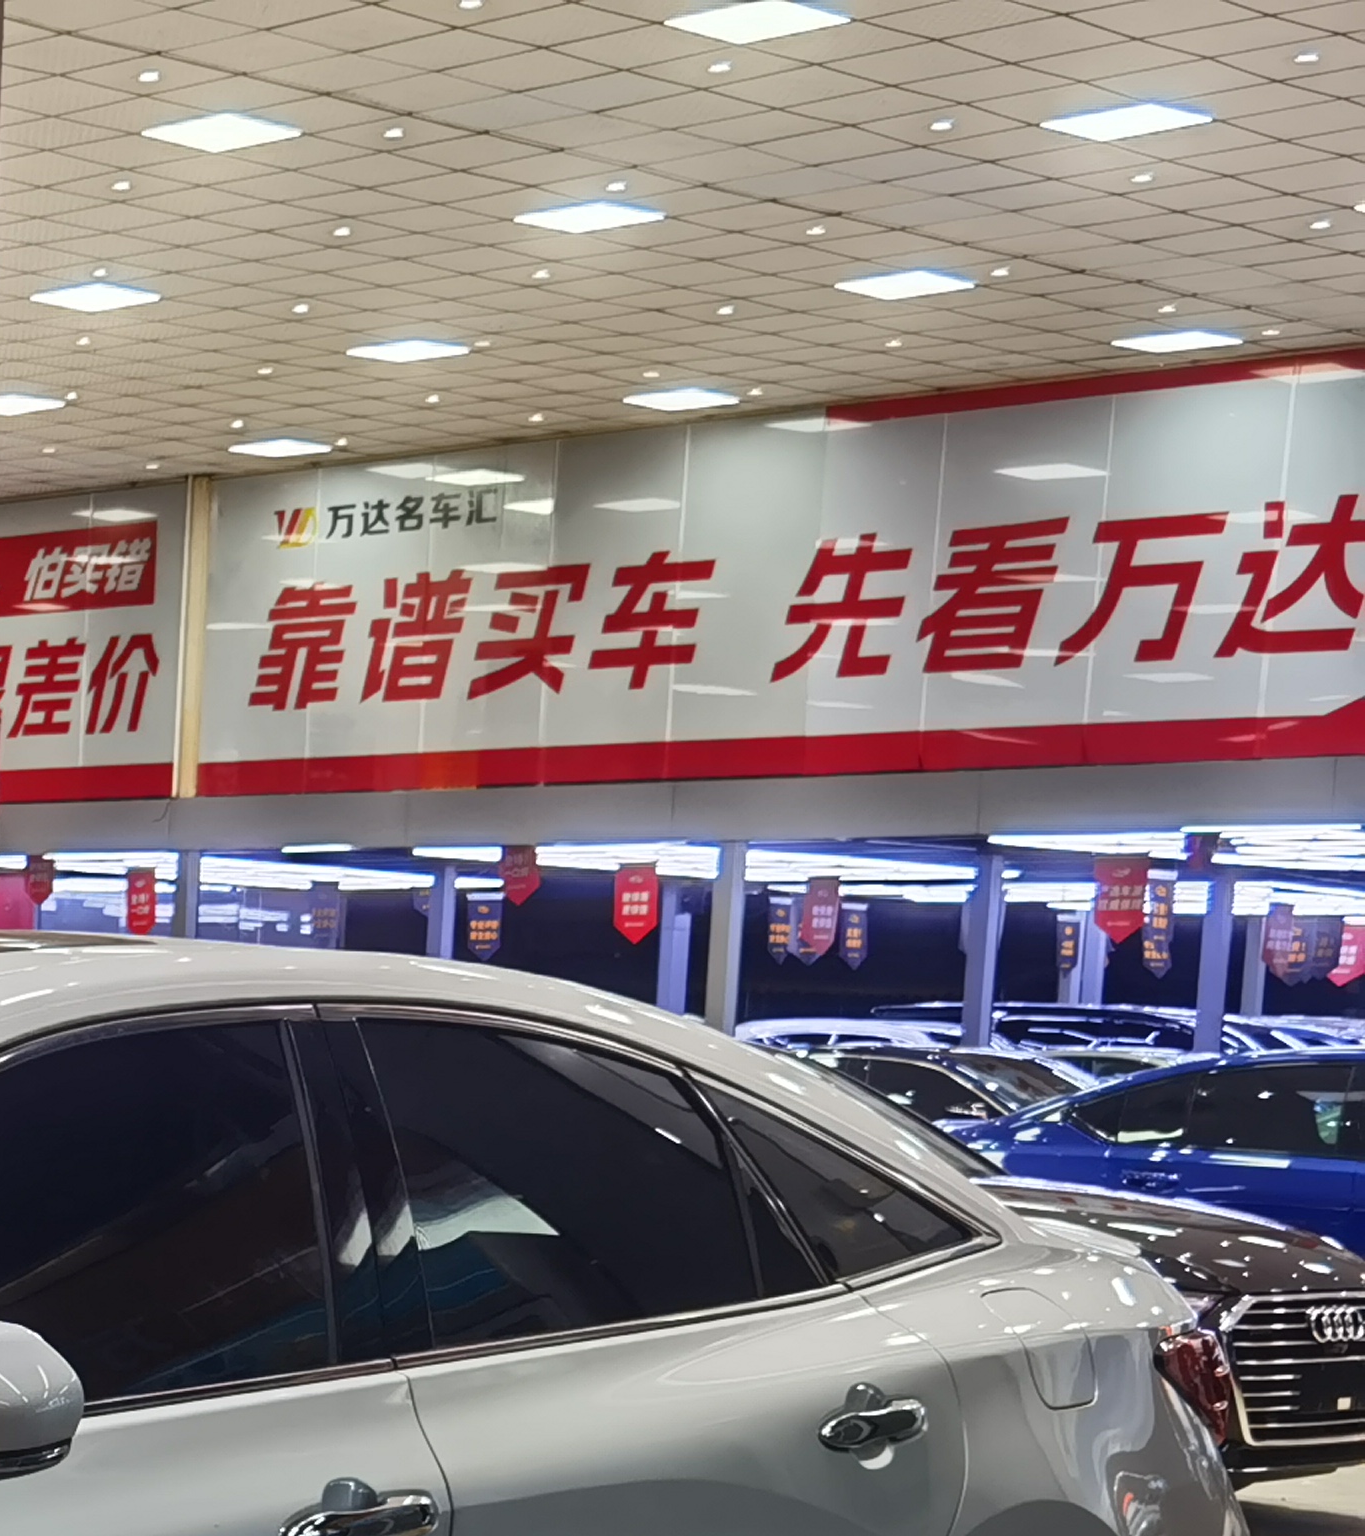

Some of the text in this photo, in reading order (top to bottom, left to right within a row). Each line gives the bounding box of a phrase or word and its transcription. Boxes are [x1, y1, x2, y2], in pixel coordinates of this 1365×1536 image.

[325, 487, 499, 539] 万达名车汇
[248, 494, 1365, 711] 靠谱买车 先看万达
